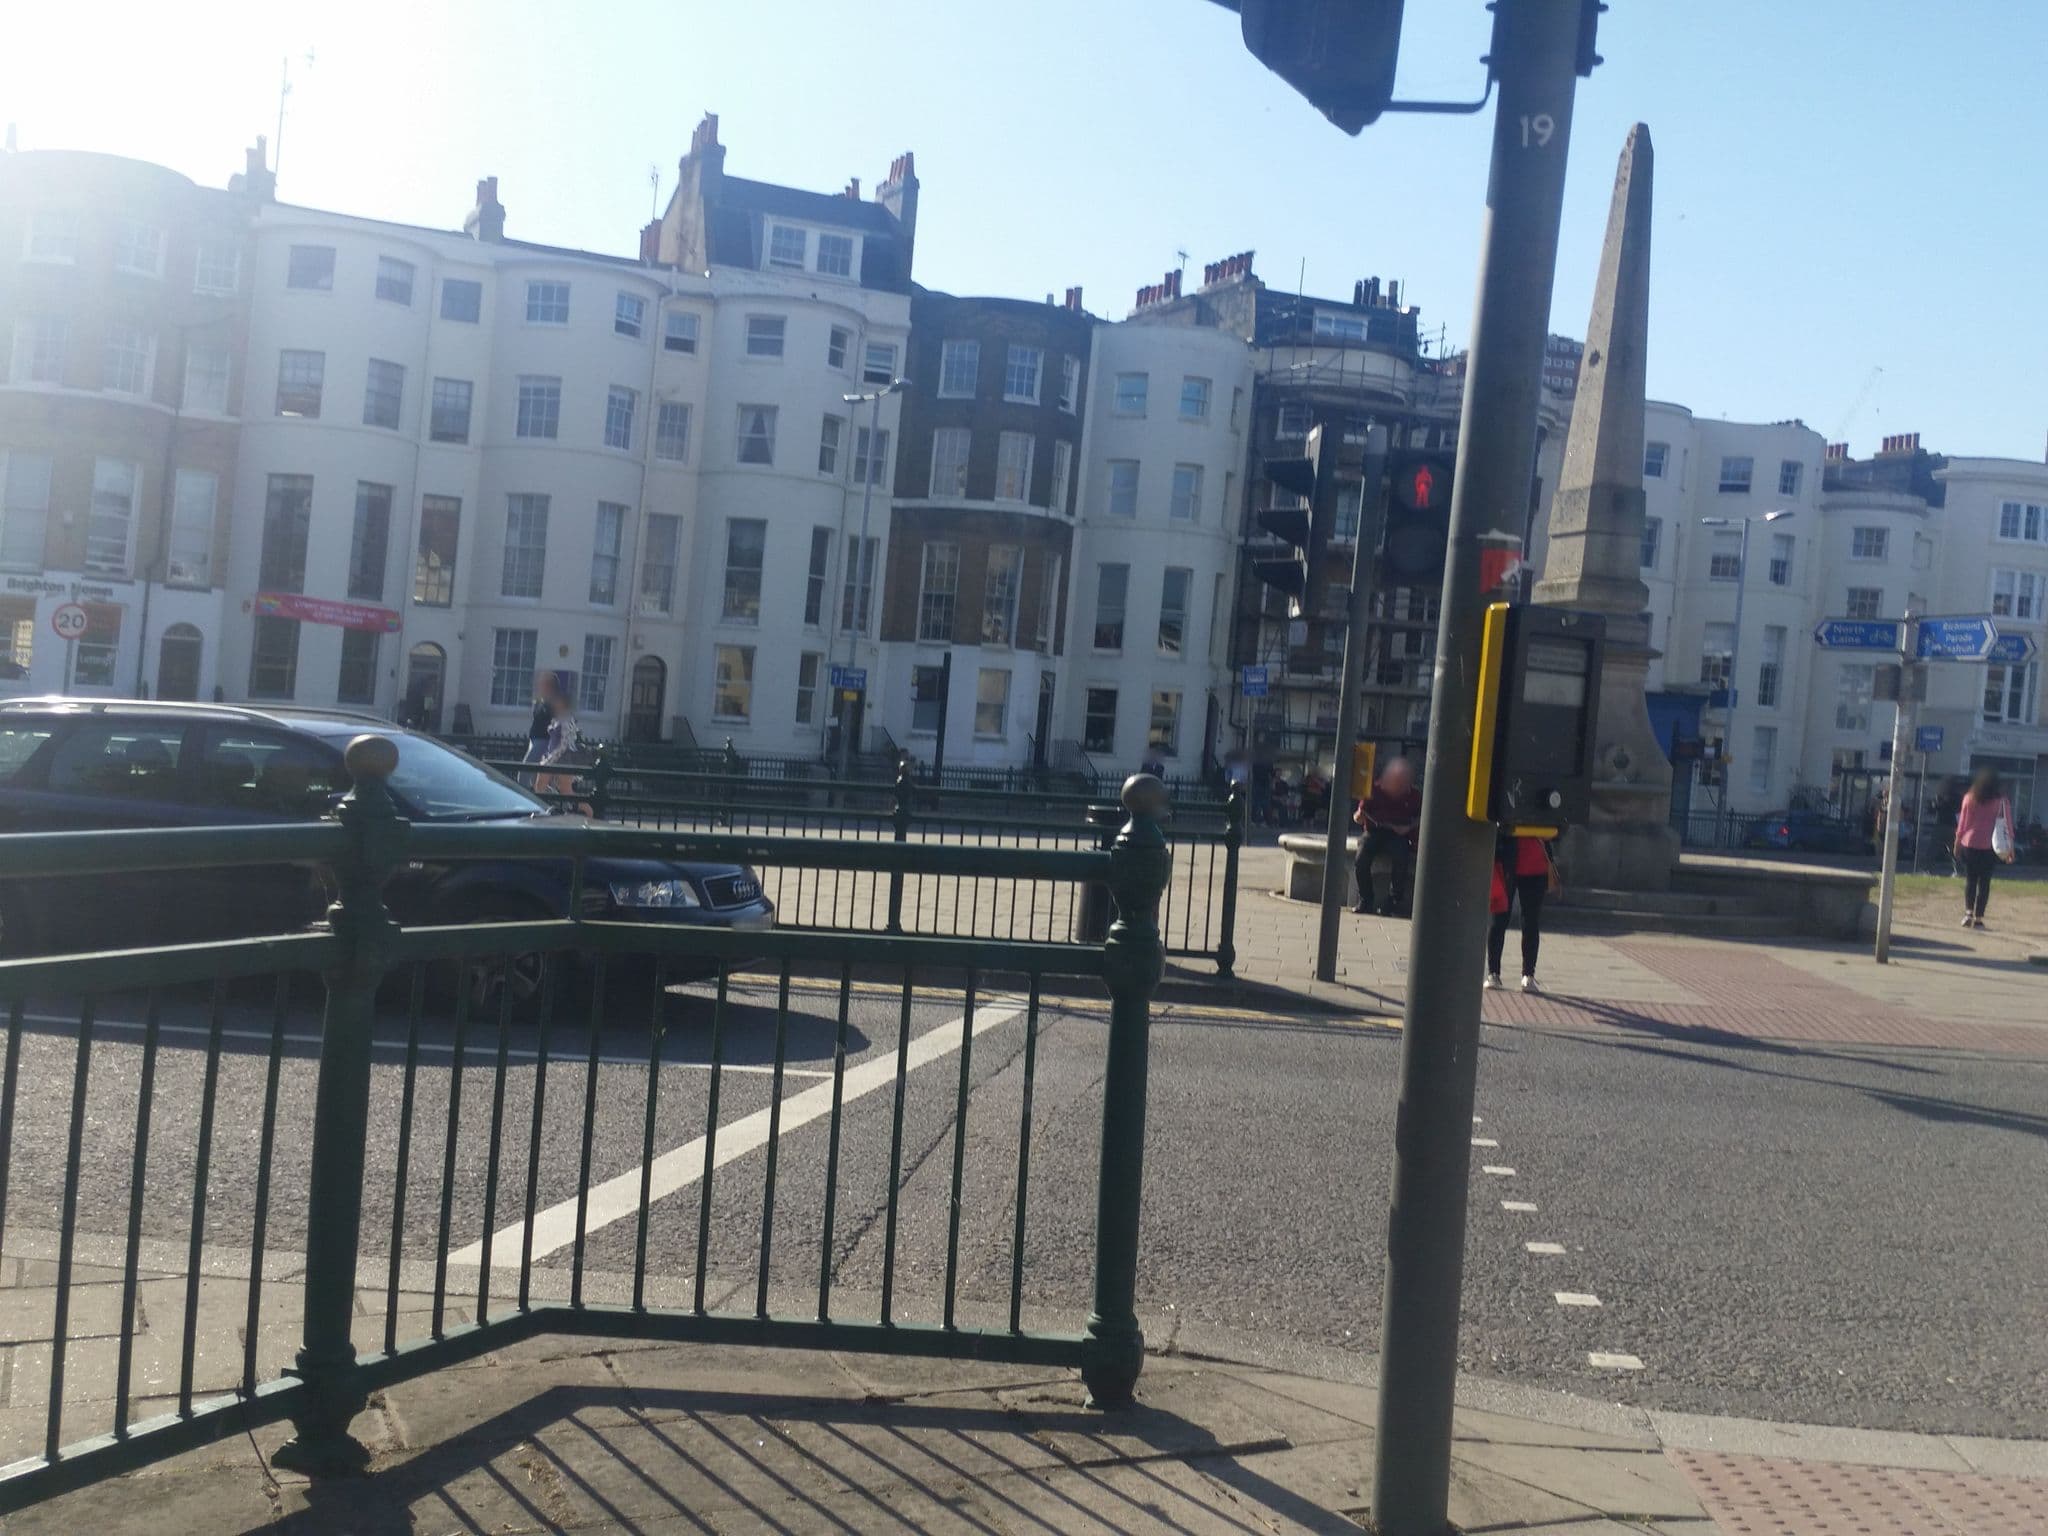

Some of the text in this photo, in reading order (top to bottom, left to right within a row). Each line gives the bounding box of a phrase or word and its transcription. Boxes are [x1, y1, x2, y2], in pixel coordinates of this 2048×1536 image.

[1520, 114, 1554, 147] 19
[8, 577, 65, 592] Brighton
[59, 613, 84, 628] 20
[1942, 621, 1981, 631] Richmond
[1833, 623, 1865, 634] North
[1832, 635, 1862, 645] Laine
[1945, 632, 1974, 643] Parade
